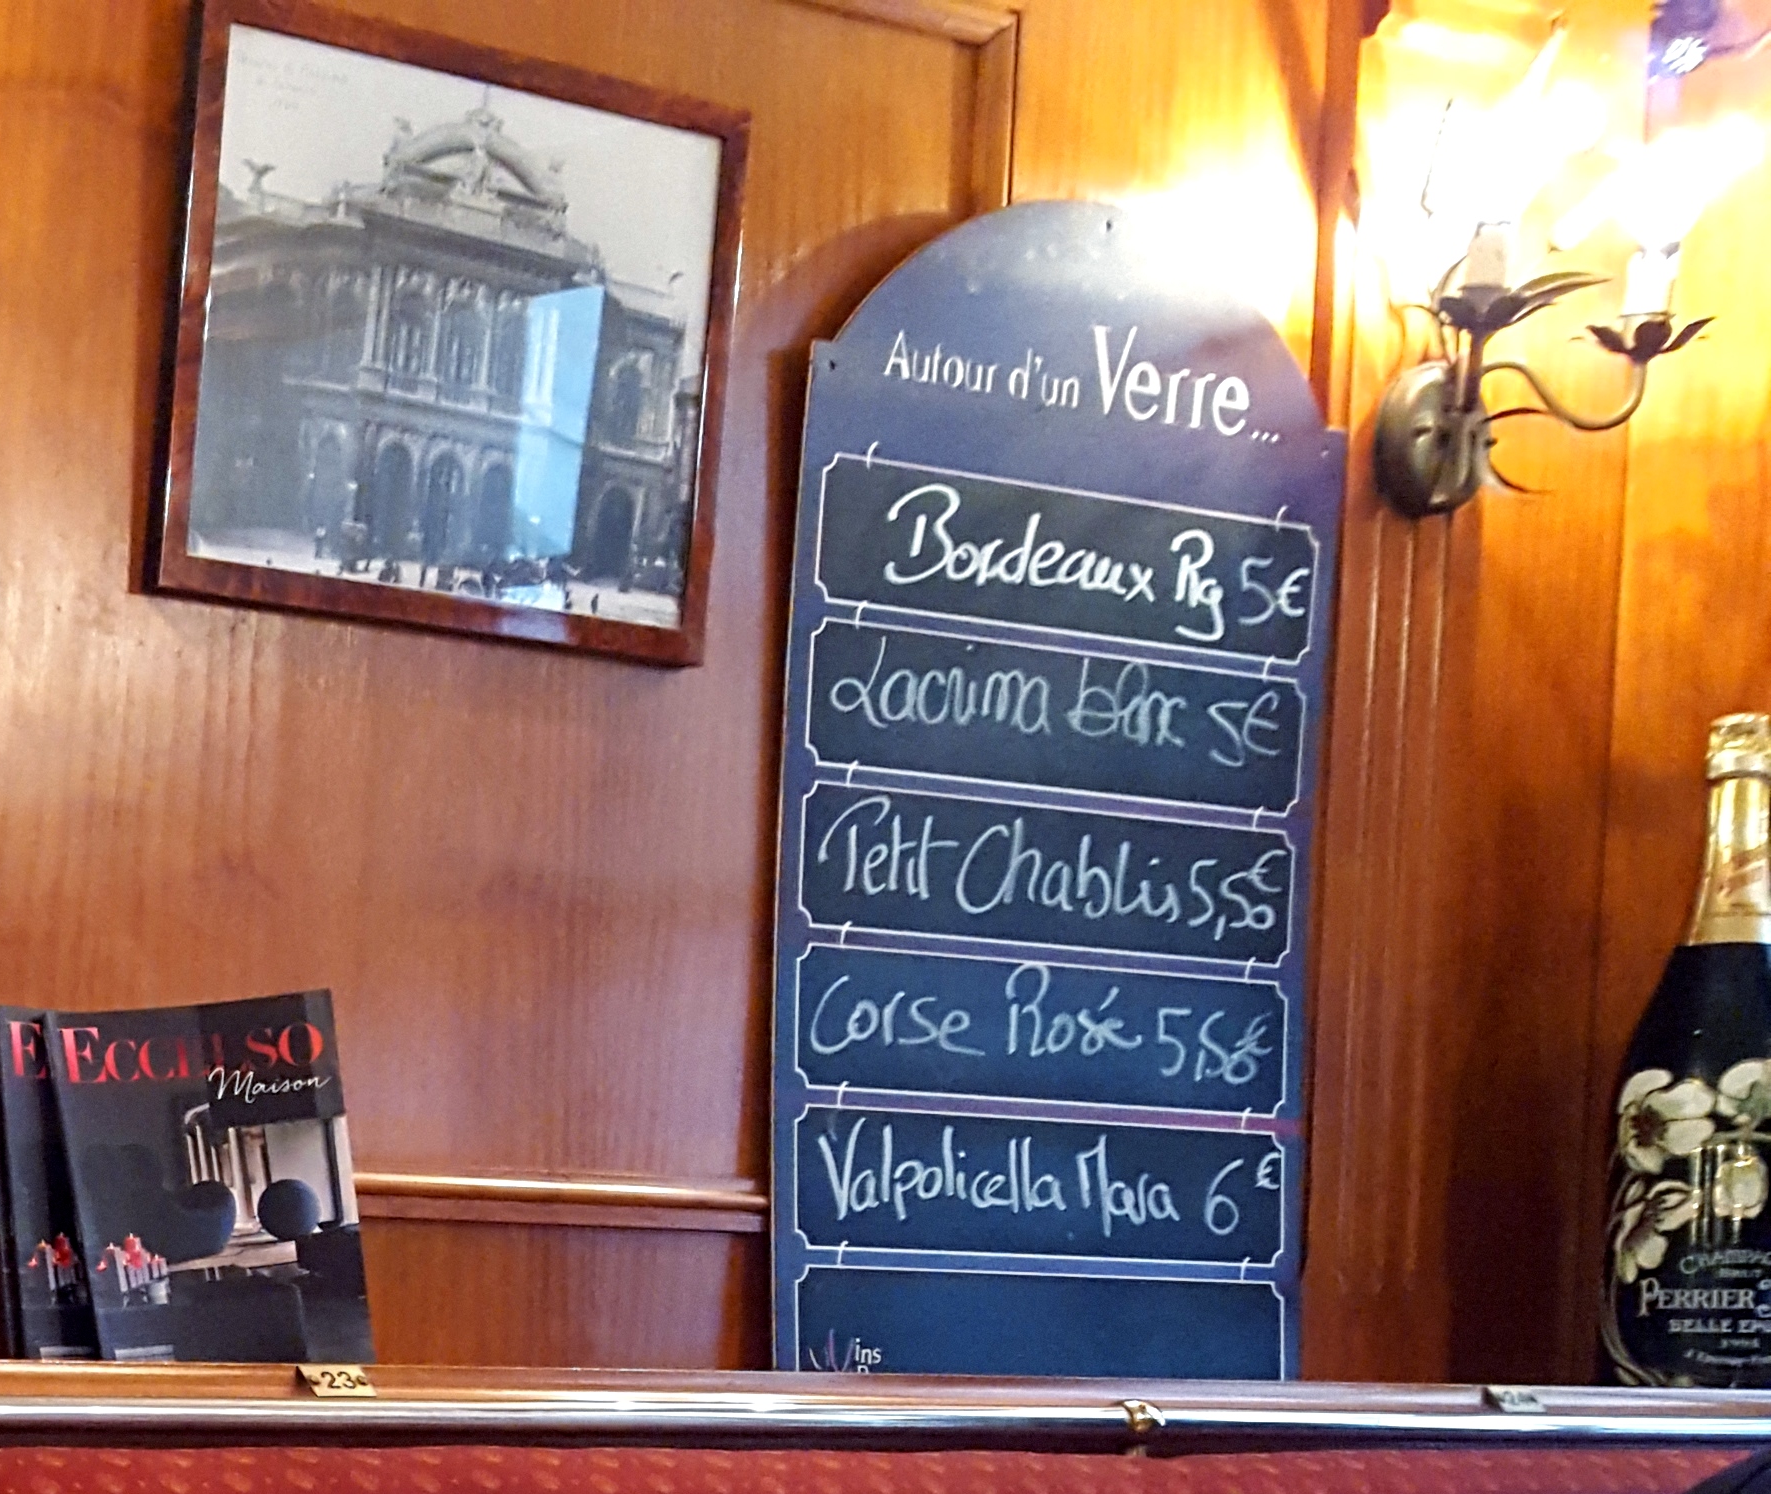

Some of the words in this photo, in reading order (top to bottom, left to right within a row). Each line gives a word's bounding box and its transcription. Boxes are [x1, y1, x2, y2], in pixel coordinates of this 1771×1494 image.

[884, 330, 995, 393] Autour
[1008, 347, 1080, 408] d'un
[884, 484, 1156, 602] Bordeaux
[1238, 555, 1311, 626] 5€
[1207, 690, 1281, 767] 5€
[818, 794, 959, 900] Petit
[957, 816, 1180, 923] Chablis
[810, 975, 986, 1056] Corse
[1005, 962, 1143, 1057] Rosé
[208, 1066, 332, 1104] Maison
[818, 1117, 1067, 1222] Valpolicella
[1636, 1277, 1756, 1318] PERRIER
[320, 1370, 357, 1390] 23
